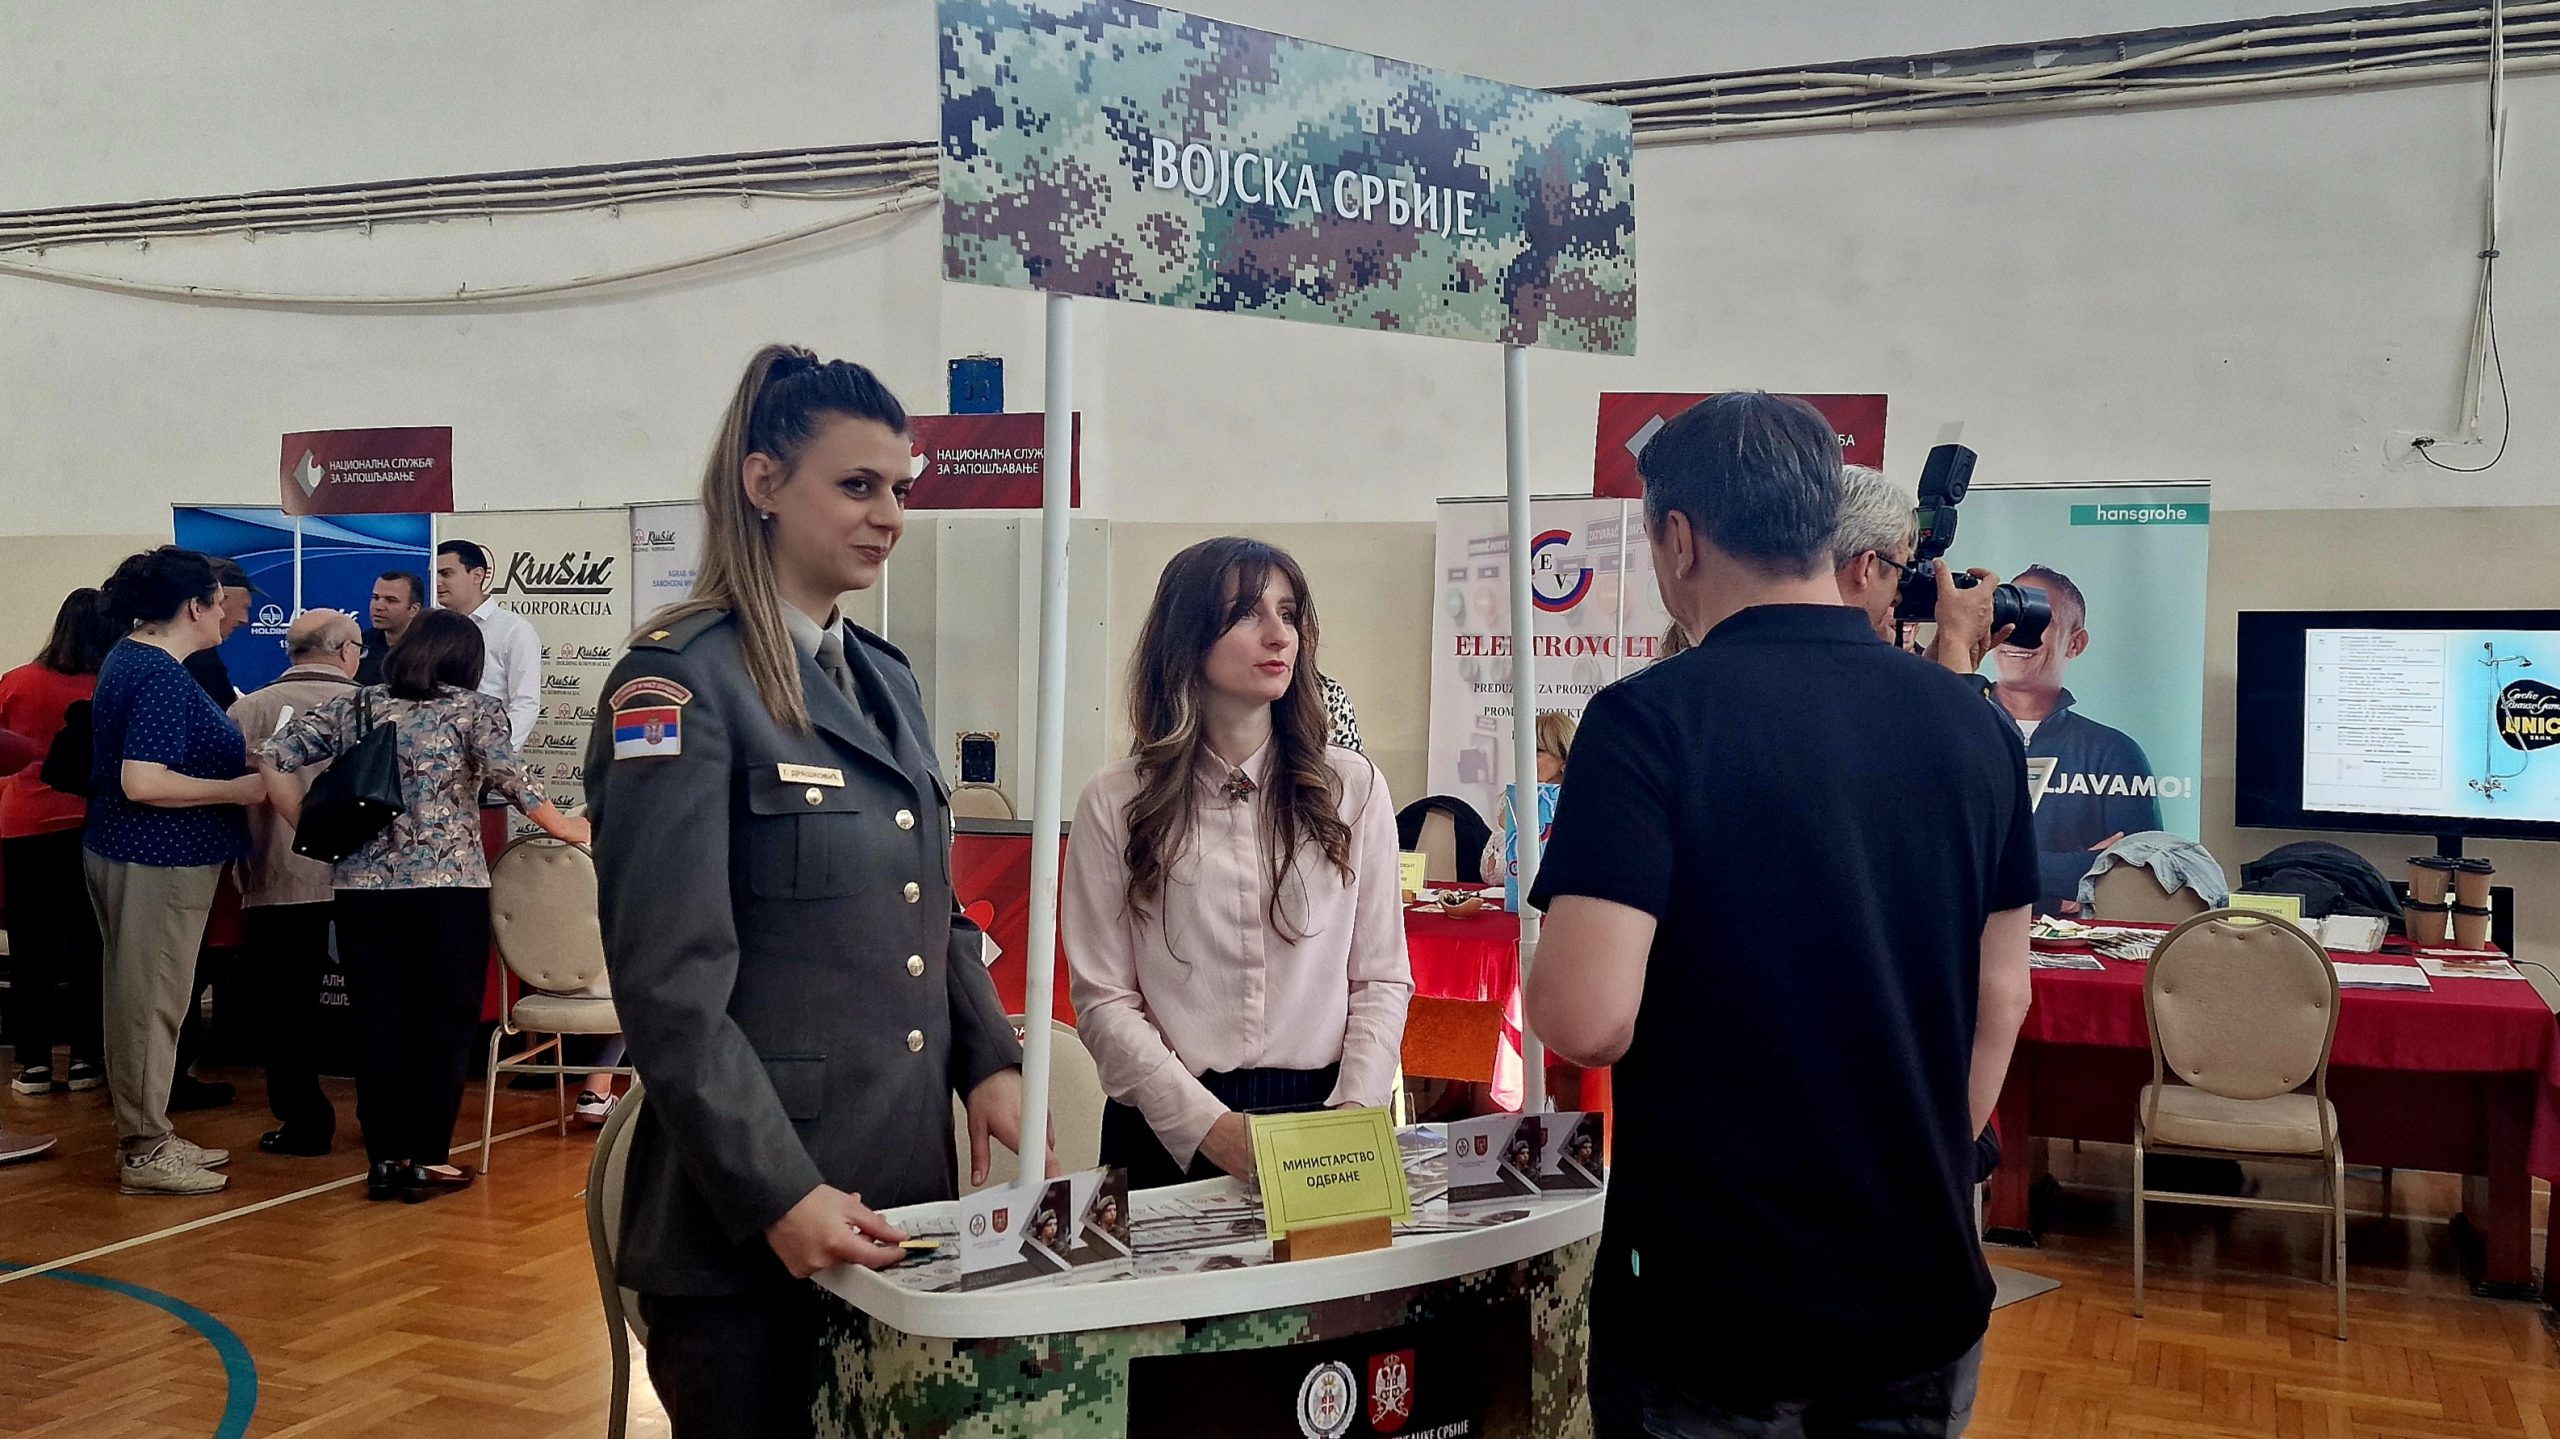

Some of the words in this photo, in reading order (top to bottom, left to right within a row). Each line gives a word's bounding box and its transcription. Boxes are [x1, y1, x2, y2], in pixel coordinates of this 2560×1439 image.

[1151, 136, 1323, 213] ВОЈСКА
[1333, 169, 1478, 240] СРБИЈЕ
[937, 448, 1012, 461] НАЦИОНАЛНА
[1013, 448, 1044, 460] СЛУЖ
[329, 459, 391, 472] НАЦИОНАЛНА
[936, 463, 950, 475] ЗА
[953, 463, 1039, 475] ЗАПОШЉАВАЊЕ
[330, 473, 341, 484] ЗА
[342, 471, 415, 483] ЗАПОШЉАВАЊЕ
[2097, 503, 2188, 523] hansgrohe
[511, 601, 612, 616] KORPORACIJA
[1454, 634, 1659, 658] ELETROVOLT
[1473, 682, 1514, 694] PREDUZ
[1538, 683, 1553, 694] ZA
[1555, 683, 1606, 695] PROIZVO
[1484, 705, 1514, 717] PROM
[1282, 1150, 1375, 1173] МИНИСТАРСТВО
[1306, 1170, 1361, 1189] ОДБРАНЕ
